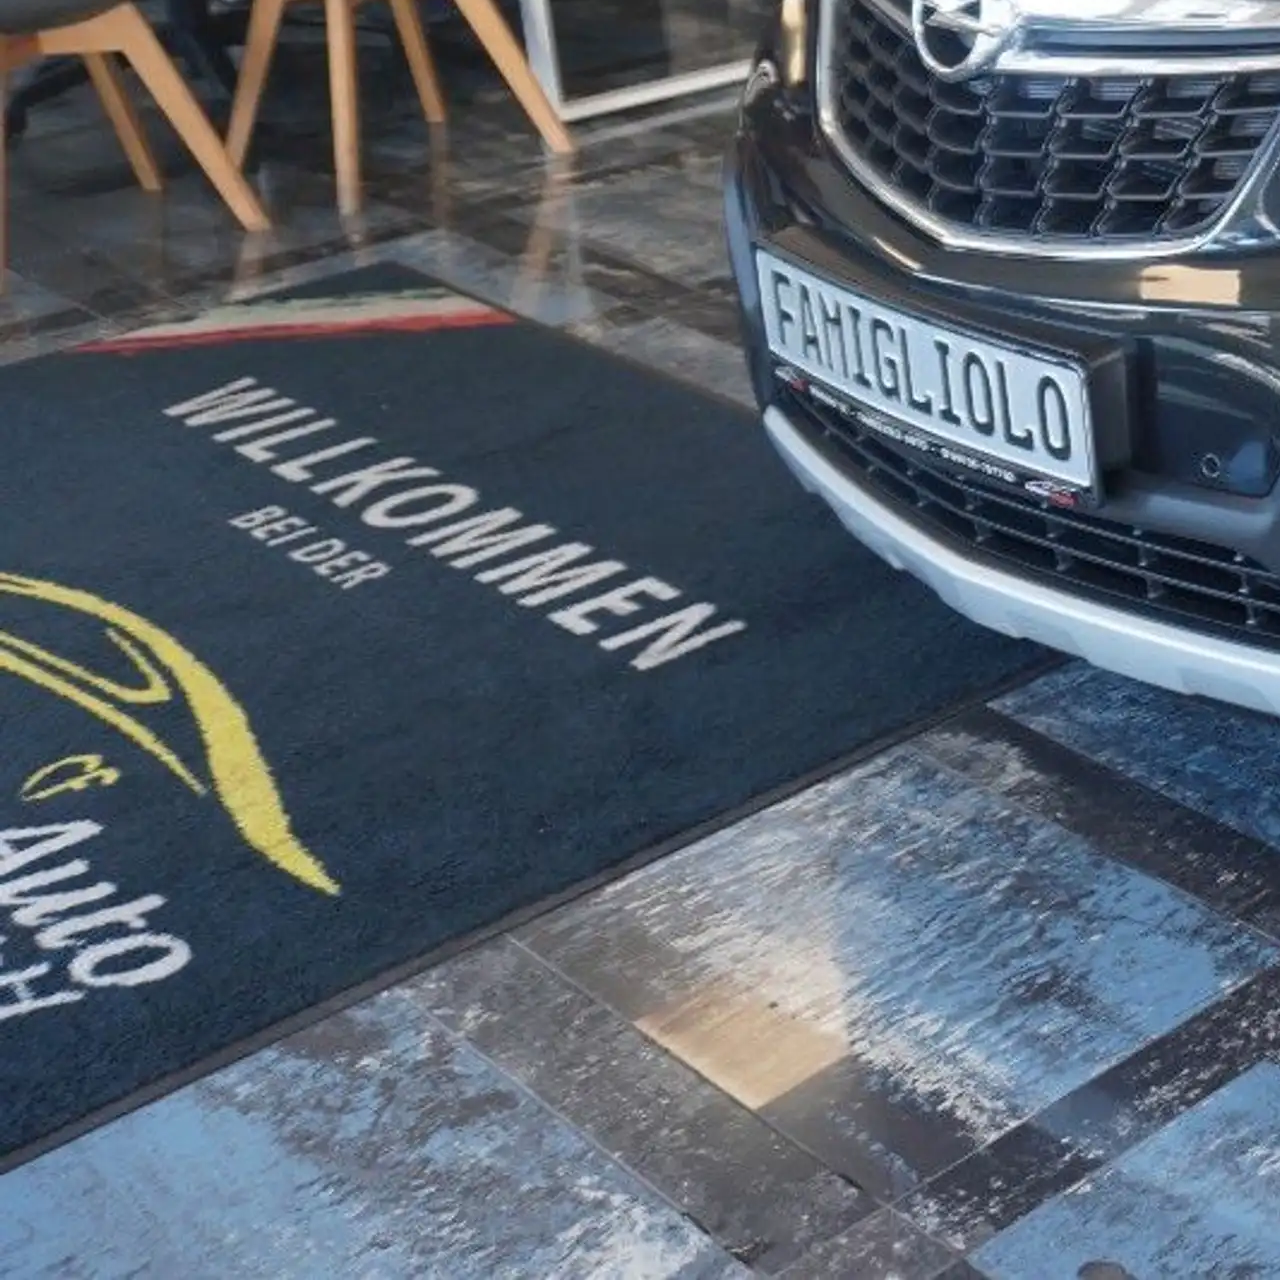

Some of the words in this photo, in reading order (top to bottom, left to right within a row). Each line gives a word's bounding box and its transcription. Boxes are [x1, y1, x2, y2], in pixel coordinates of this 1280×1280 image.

[770, 269, 1071, 461] FAMIGLIOLO
[161, 376, 748, 671] WILLKOMMEN
[227, 504, 318, 548] BEI
[287, 537, 393, 590] DER
